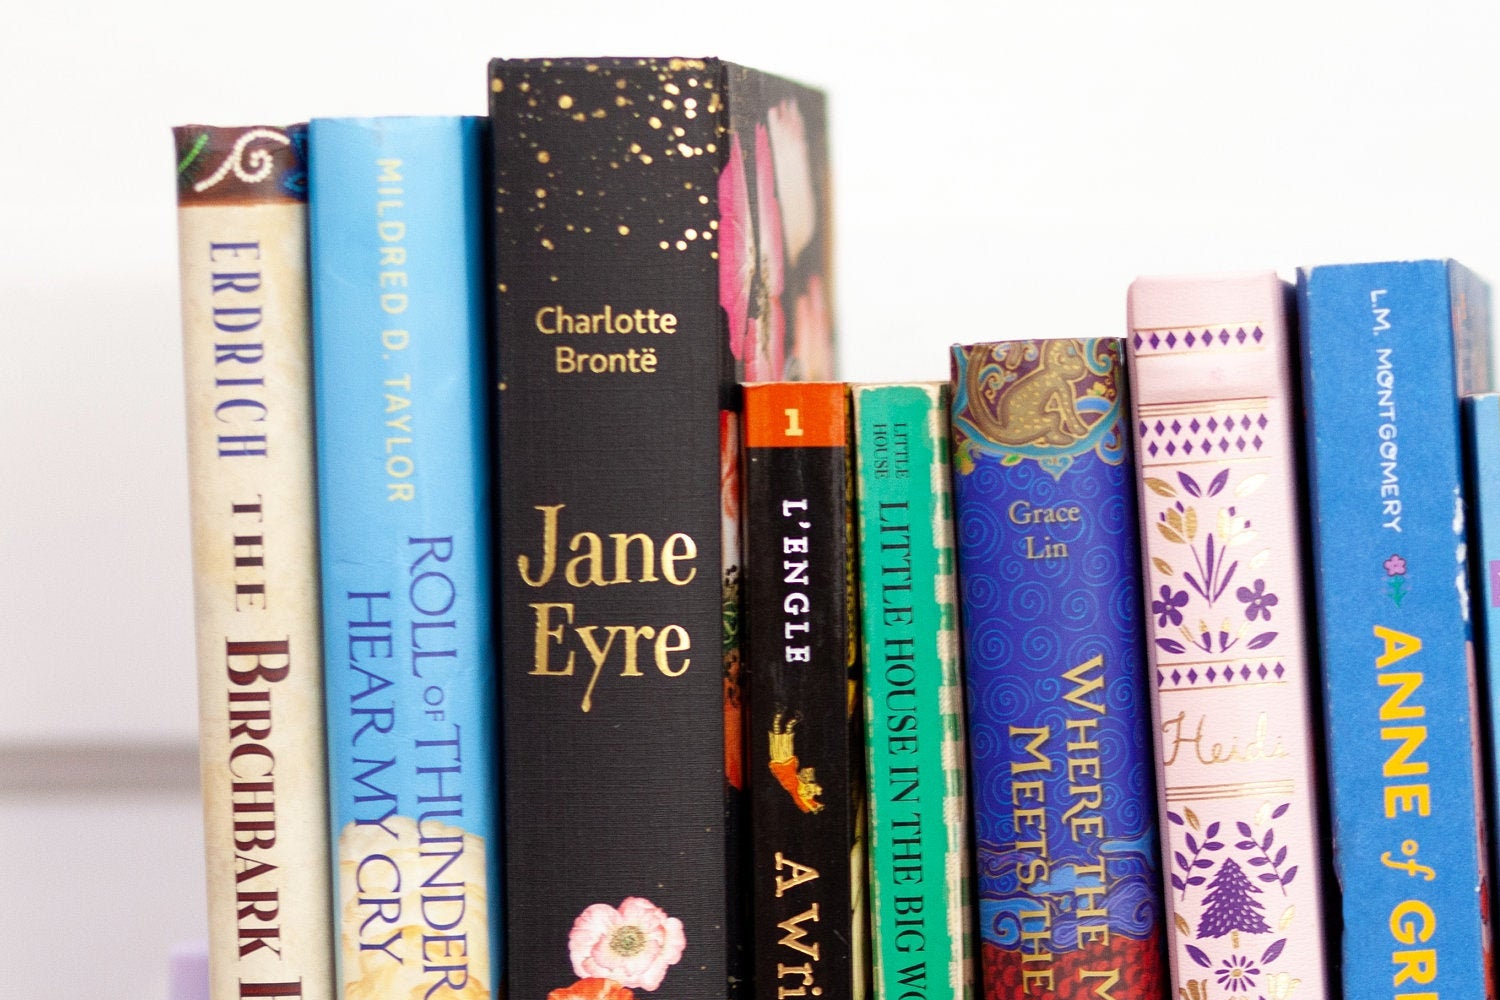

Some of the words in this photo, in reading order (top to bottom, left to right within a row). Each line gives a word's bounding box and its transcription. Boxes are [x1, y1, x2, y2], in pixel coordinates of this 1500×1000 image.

[376, 157, 409, 316] MILDRED
[210, 240, 268, 458] ERDRICH
[381, 329, 410, 361] D.
[535, 304, 678, 335] Charlotte
[555, 346, 658, 374] Brontë
[384, 374, 416, 502] TAYLOR
[784, 408, 804, 437] 1
[872, 424, 890, 480] HOUSE
[893, 422, 910, 479] LITTLE
[1375, 348, 1403, 533] MONTGOMERY
[231, 494, 267, 612] THE
[517, 503, 698, 588] Jane
[1007, 500, 1082, 526] Grace
[1024, 537, 1069, 561] Lin
[408, 535, 459, 679] ROLL
[782, 498, 812, 664] L'ENGLE
[878, 500, 914, 628] LITTLE
[346, 590, 398, 747] HEAR
[527, 602, 692, 713] Eyre
[884, 635, 919, 756] HOUSE
[422, 684, 446, 722] OF
[1161, 709, 1290, 768] Heidi
[1373, 624, 1432, 819] ANNE
[889, 765, 921, 804] IN
[1060, 654, 1107, 841] WHERE
[225, 635, 290, 961] BIRCHBARK
[351, 757, 400, 841] MY
[1008, 724, 1053, 886] MEETS
[774, 851, 821, 898] A
[891, 811, 924, 886] THE
[1380, 838, 1436, 882] of
[355, 853, 404, 966] CRY
[894, 891, 926, 954] BIG
[1073, 856, 1111, 951] THE
[1019, 908, 1055, 996] THE
